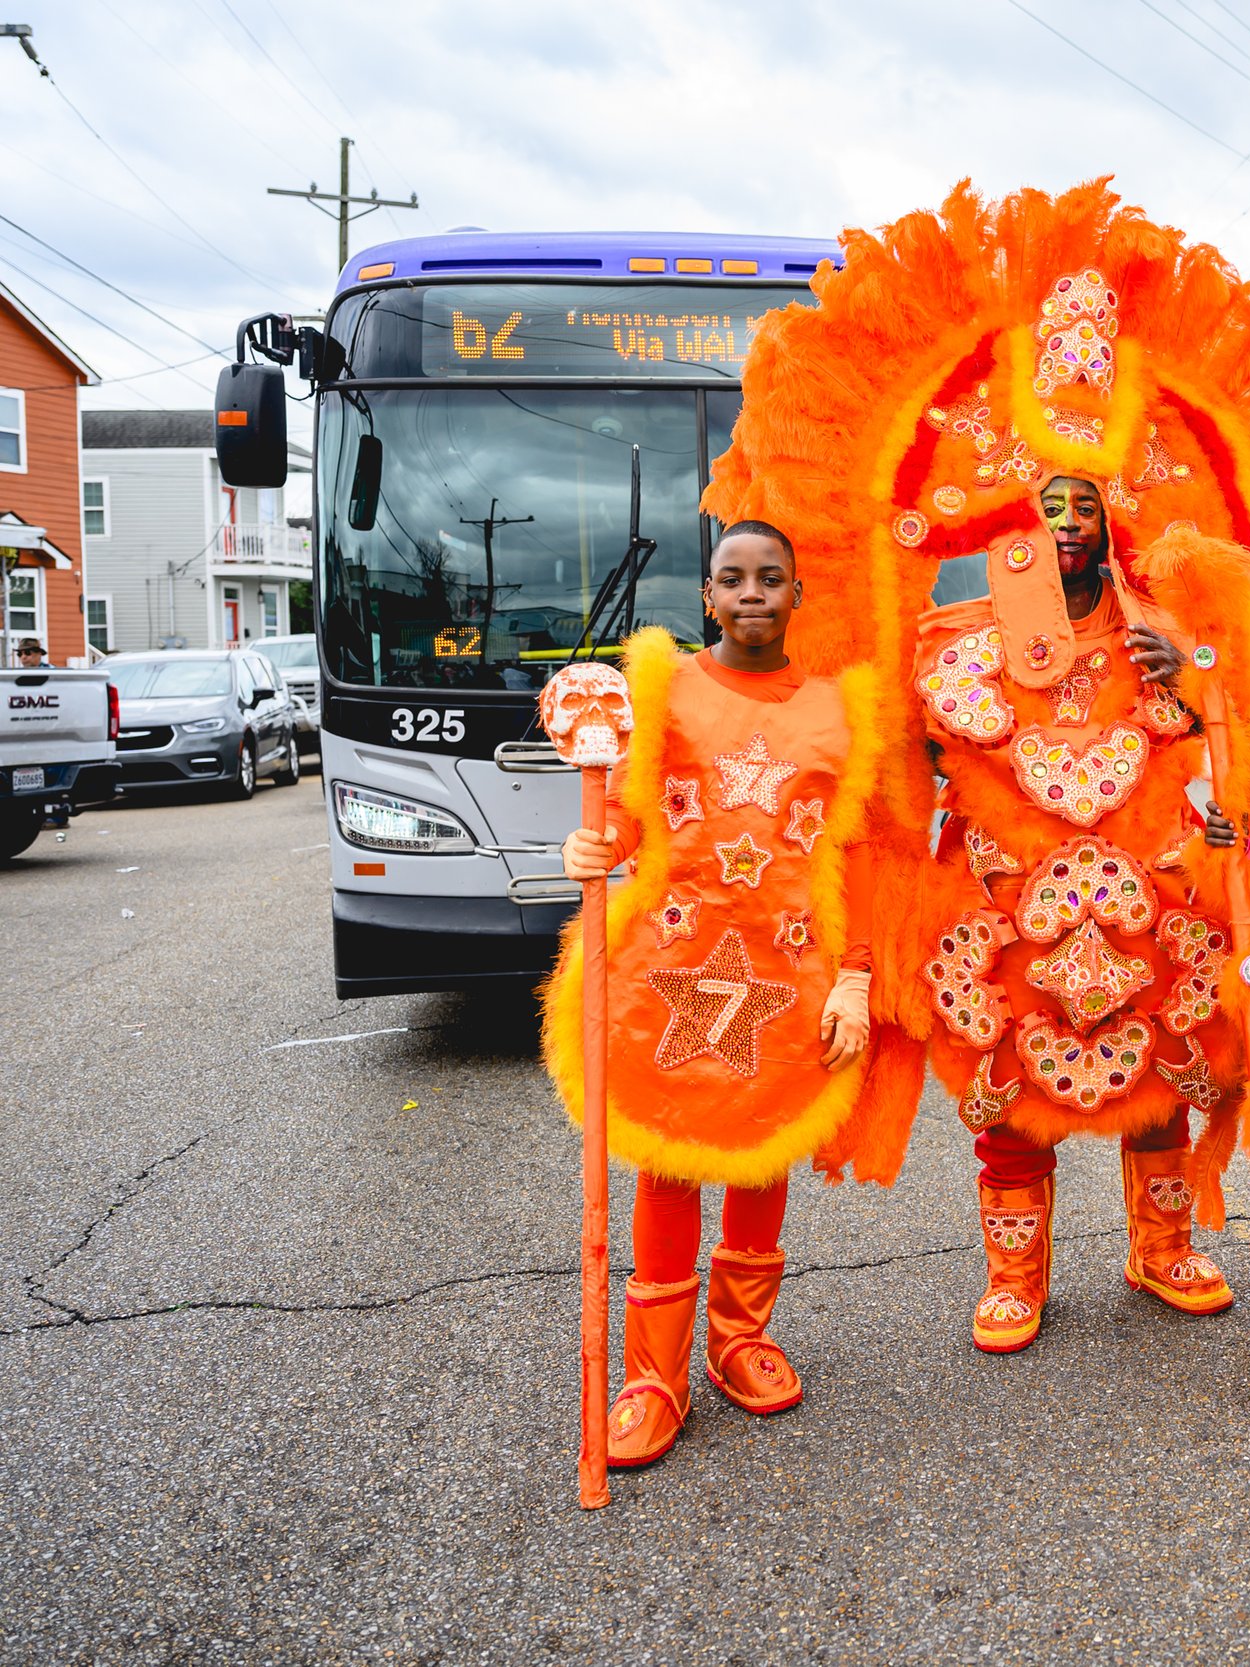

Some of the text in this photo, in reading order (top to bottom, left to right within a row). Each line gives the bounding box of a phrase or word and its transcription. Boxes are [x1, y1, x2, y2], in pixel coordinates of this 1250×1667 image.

[452, 311, 525, 359] 62
[613, 329, 753, 362] Via WAL
[434, 626, 482, 657] 62
[8, 695, 60, 709] GMC
[391, 708, 466, 743] 325
[697, 979, 748, 1044] 7
